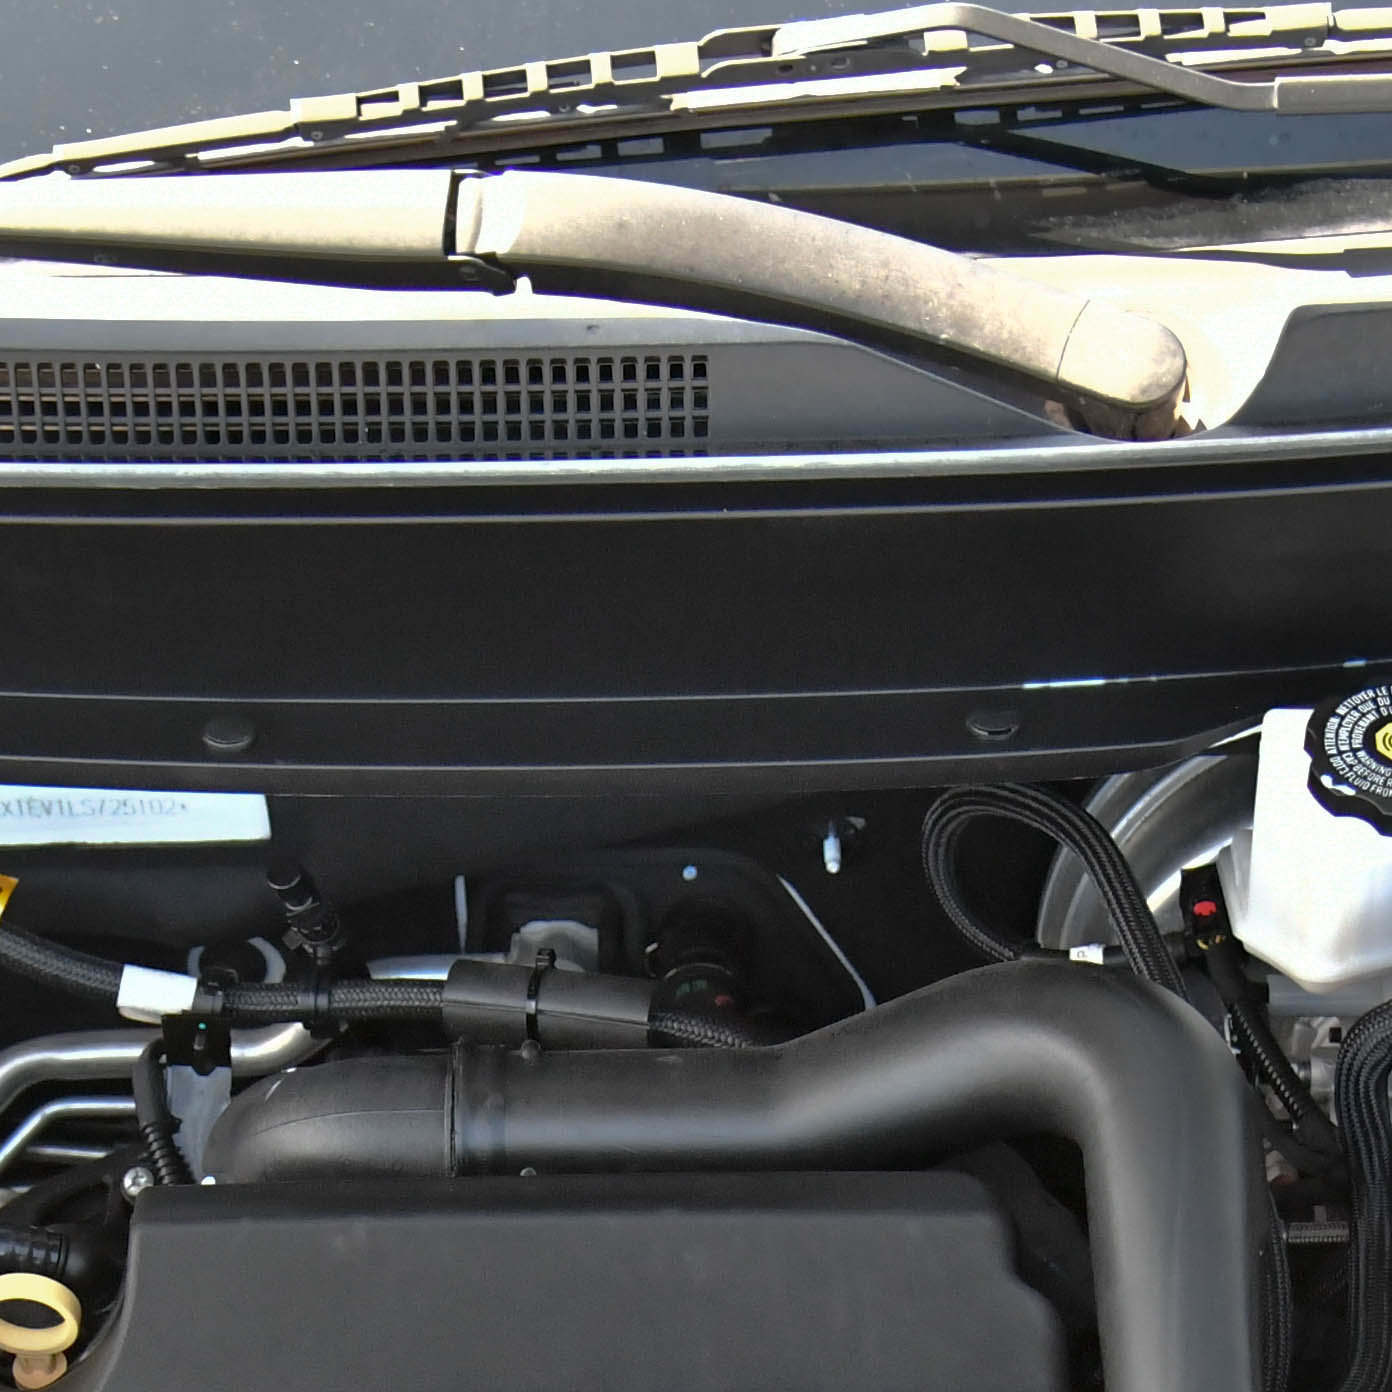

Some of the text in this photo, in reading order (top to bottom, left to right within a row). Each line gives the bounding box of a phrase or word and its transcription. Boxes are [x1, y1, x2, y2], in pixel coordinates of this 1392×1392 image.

[1335, 689, 1375, 716] NETTOYER
[1375, 686, 1388, 697] LE
[1357, 700, 1377, 713] QUE
[1376, 696, 1390, 706] DU
[1342, 752, 1358, 765] CAP
[1353, 764, 1385, 786] BEFORE
[1344, 771, 1371, 790] FLUID
